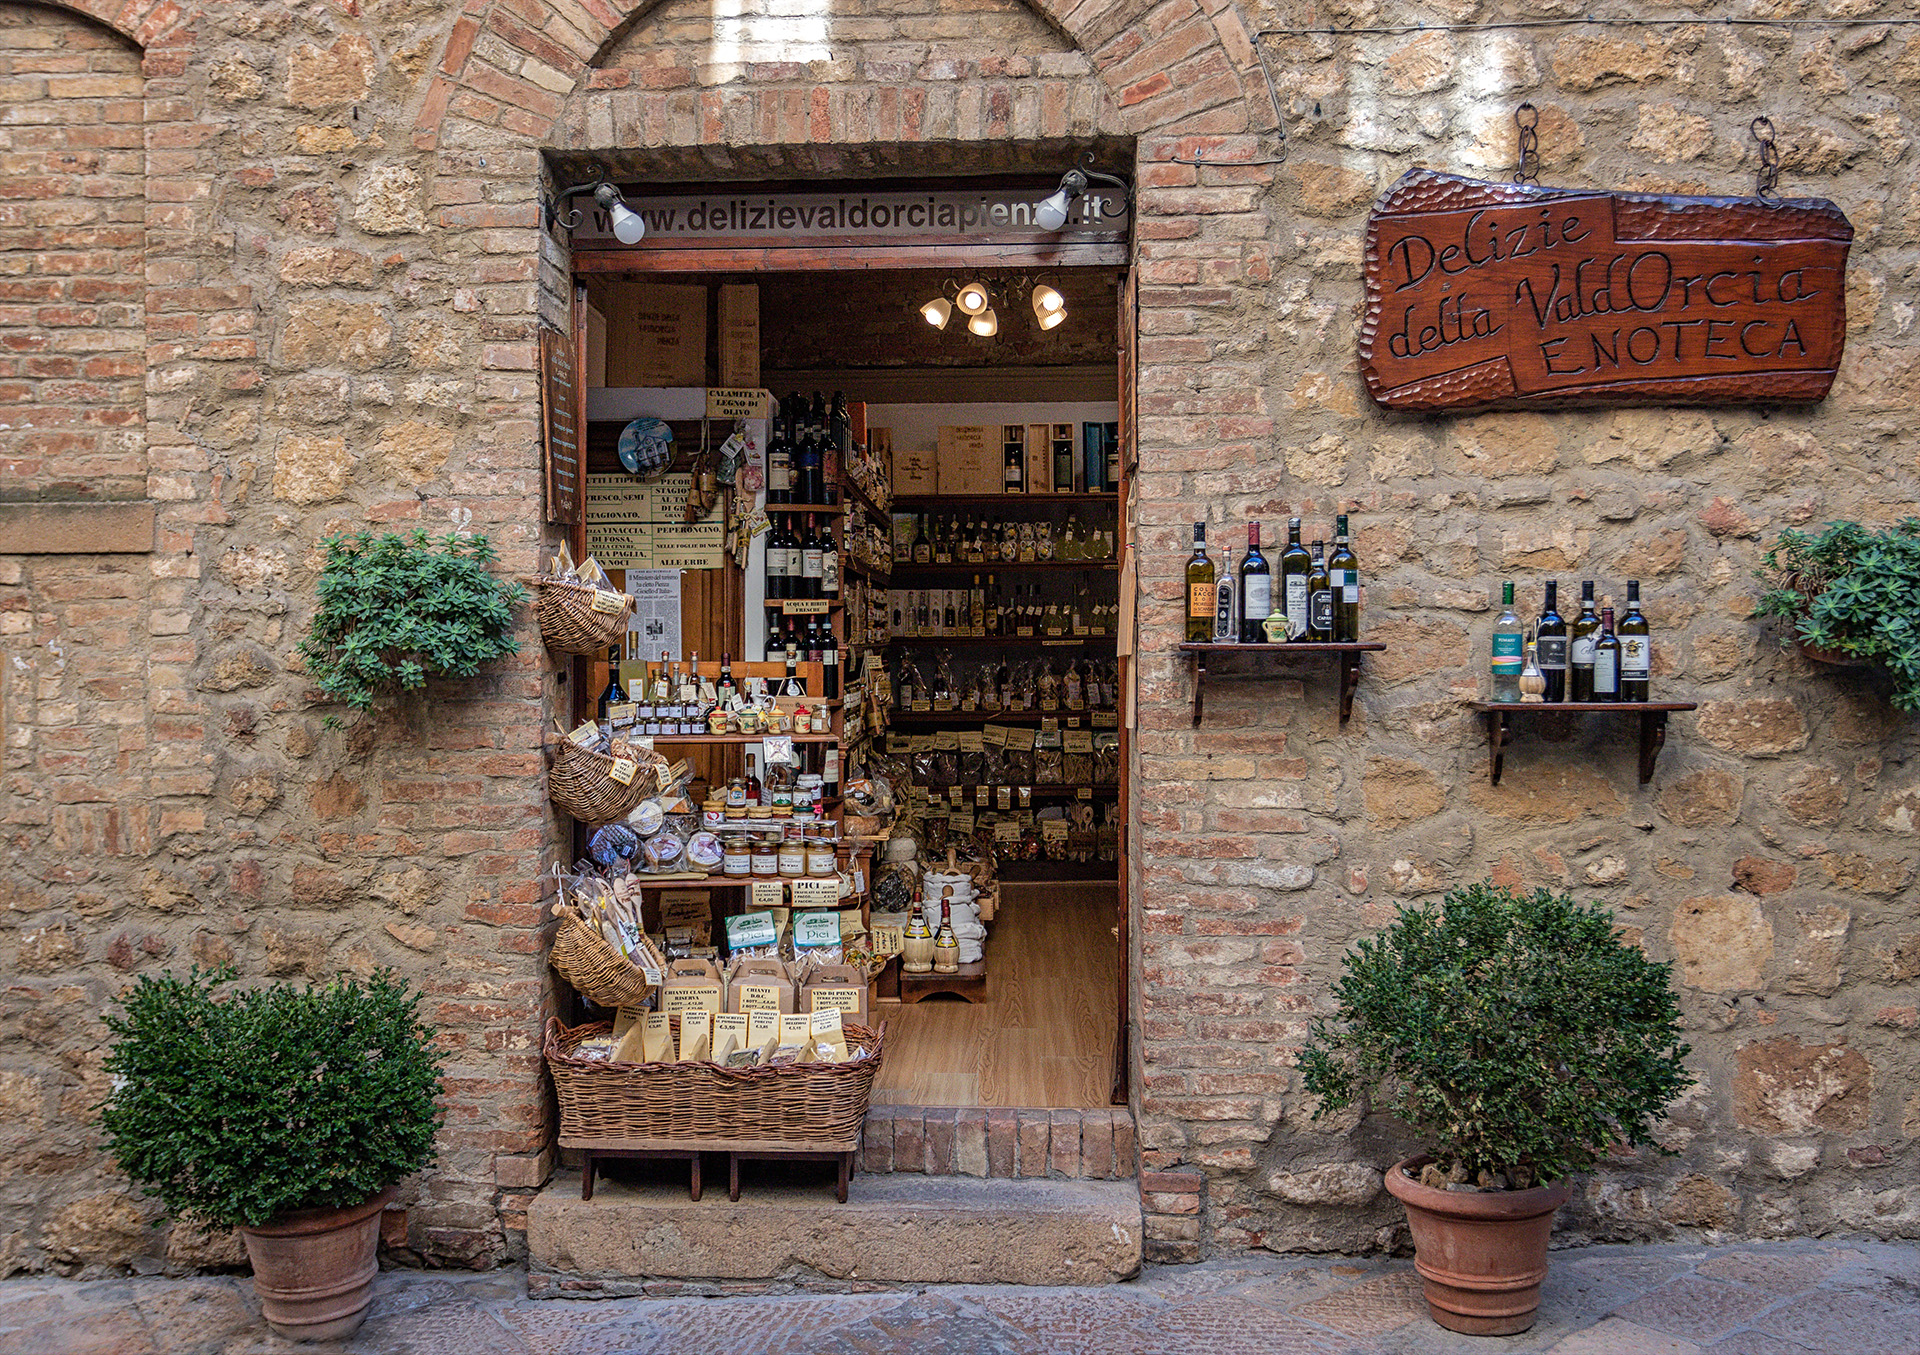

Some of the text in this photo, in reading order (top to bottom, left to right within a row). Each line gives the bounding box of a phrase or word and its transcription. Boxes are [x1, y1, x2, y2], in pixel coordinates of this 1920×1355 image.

[593, 192, 1103, 234] ww.delizievaldorciapien.it
[1388, 210, 1591, 293] Delizie
[1540, 319, 1807, 377] ENOTECA
[709, 390, 754, 398] CALAMITE
[716, 399, 746, 407] LEGNO
[723, 408, 750, 416] OLIVO
[586, 476, 606, 484] UTTI
[614, 476, 634, 484] TIPI
[635, 476, 646, 484] DI
[603, 527, 646, 535] VINACCIA,
[604, 536, 633, 544] FOSSA,
[612, 551, 647, 559] PAGLIA,
[740, 929, 765, 942] Pici
[806, 930, 829, 939] Pici
